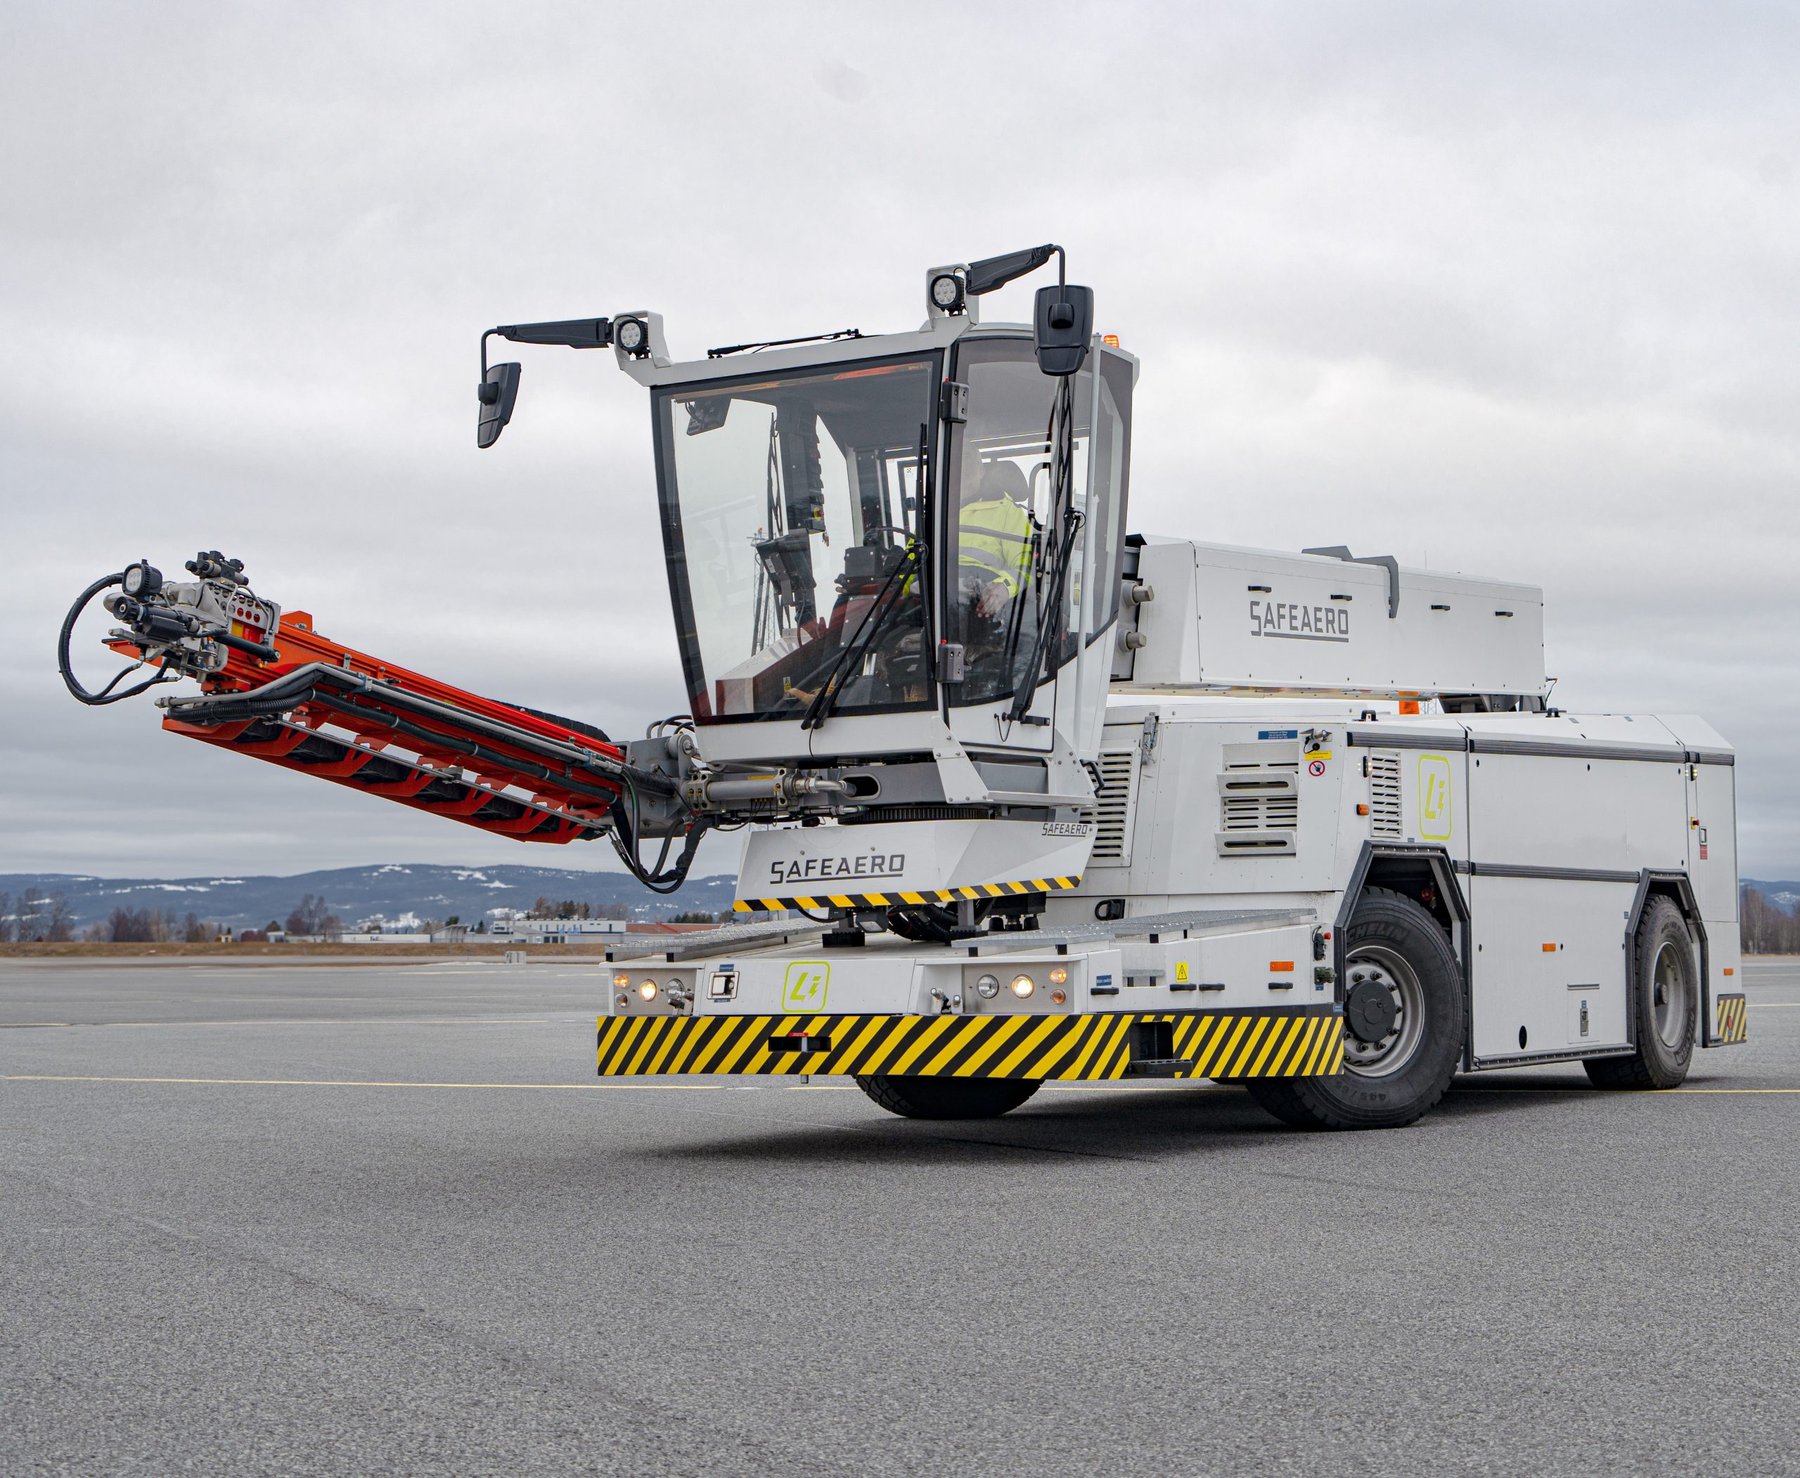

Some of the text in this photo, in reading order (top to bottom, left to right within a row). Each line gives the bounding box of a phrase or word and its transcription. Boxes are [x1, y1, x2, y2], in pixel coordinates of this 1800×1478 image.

[1250, 600, 1349, 637] SAFEAERO
[1425, 773, 1446, 820] Li
[1042, 823, 1088, 836] SAFEAERO
[770, 854, 905, 884] SAFEAERO
[1347, 922, 1409, 943] CHELIN
[790, 972, 822, 1001] Li
